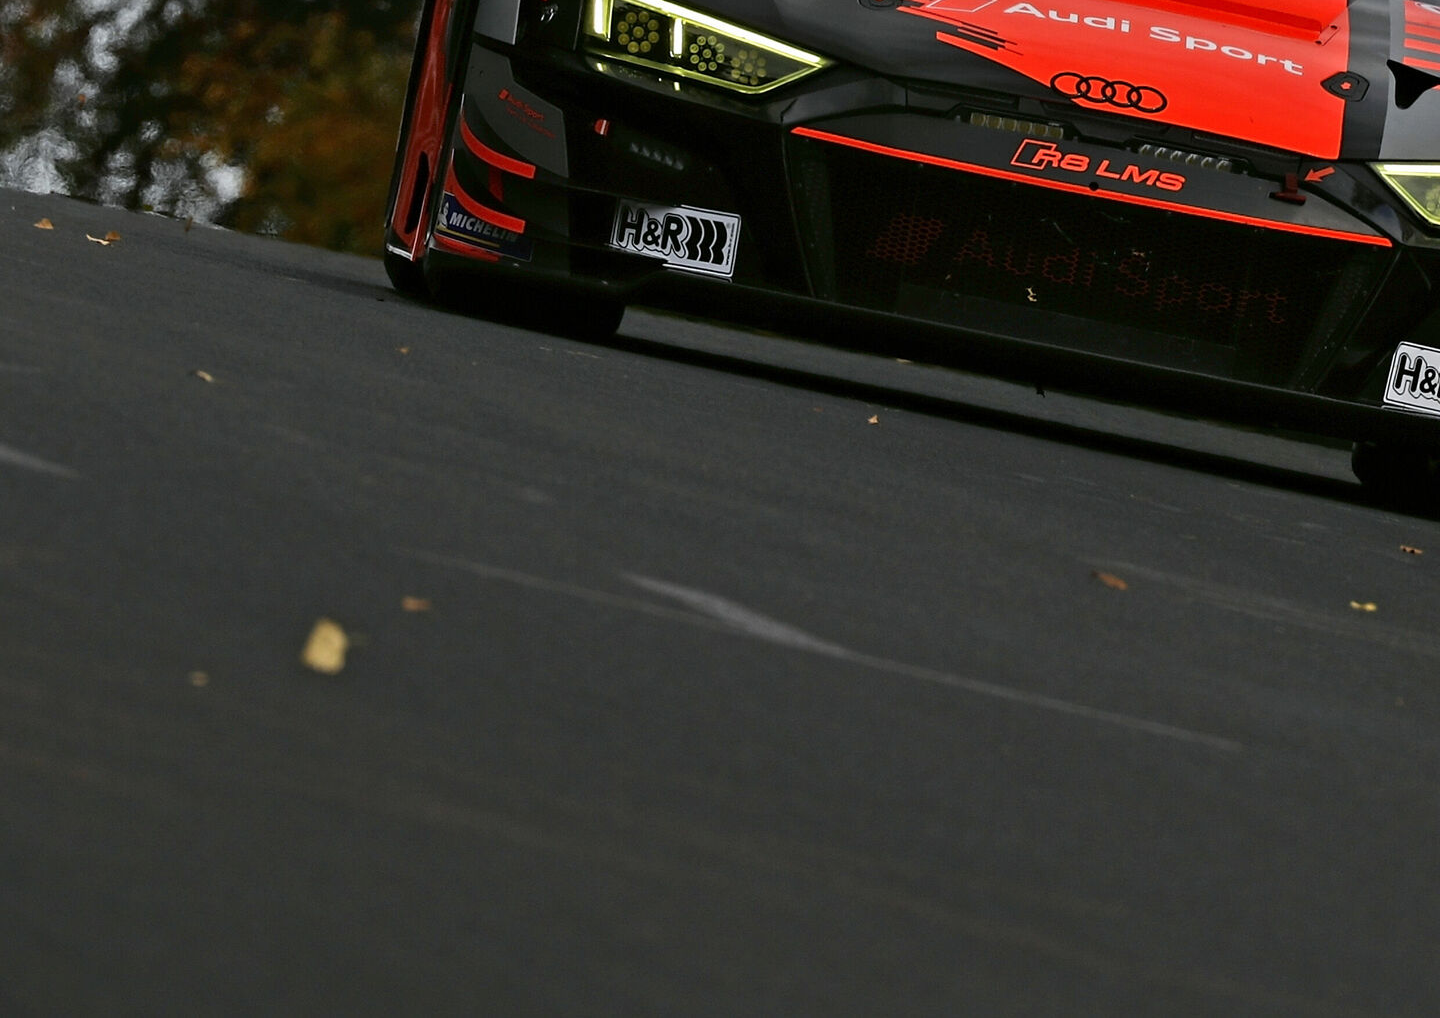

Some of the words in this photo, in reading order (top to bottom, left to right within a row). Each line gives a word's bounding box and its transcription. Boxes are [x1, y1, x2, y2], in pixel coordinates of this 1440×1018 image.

[1004, 2, 1130, 33] Audi
[1149, 26, 1304, 76] Sport
[1031, 148, 1090, 172] R8
[1096, 160, 1187, 192] LMS
[449, 212, 520, 244] MICHELIN
[956, 229, 1097, 287] Audi
[1114, 250, 1288, 325] Sport
